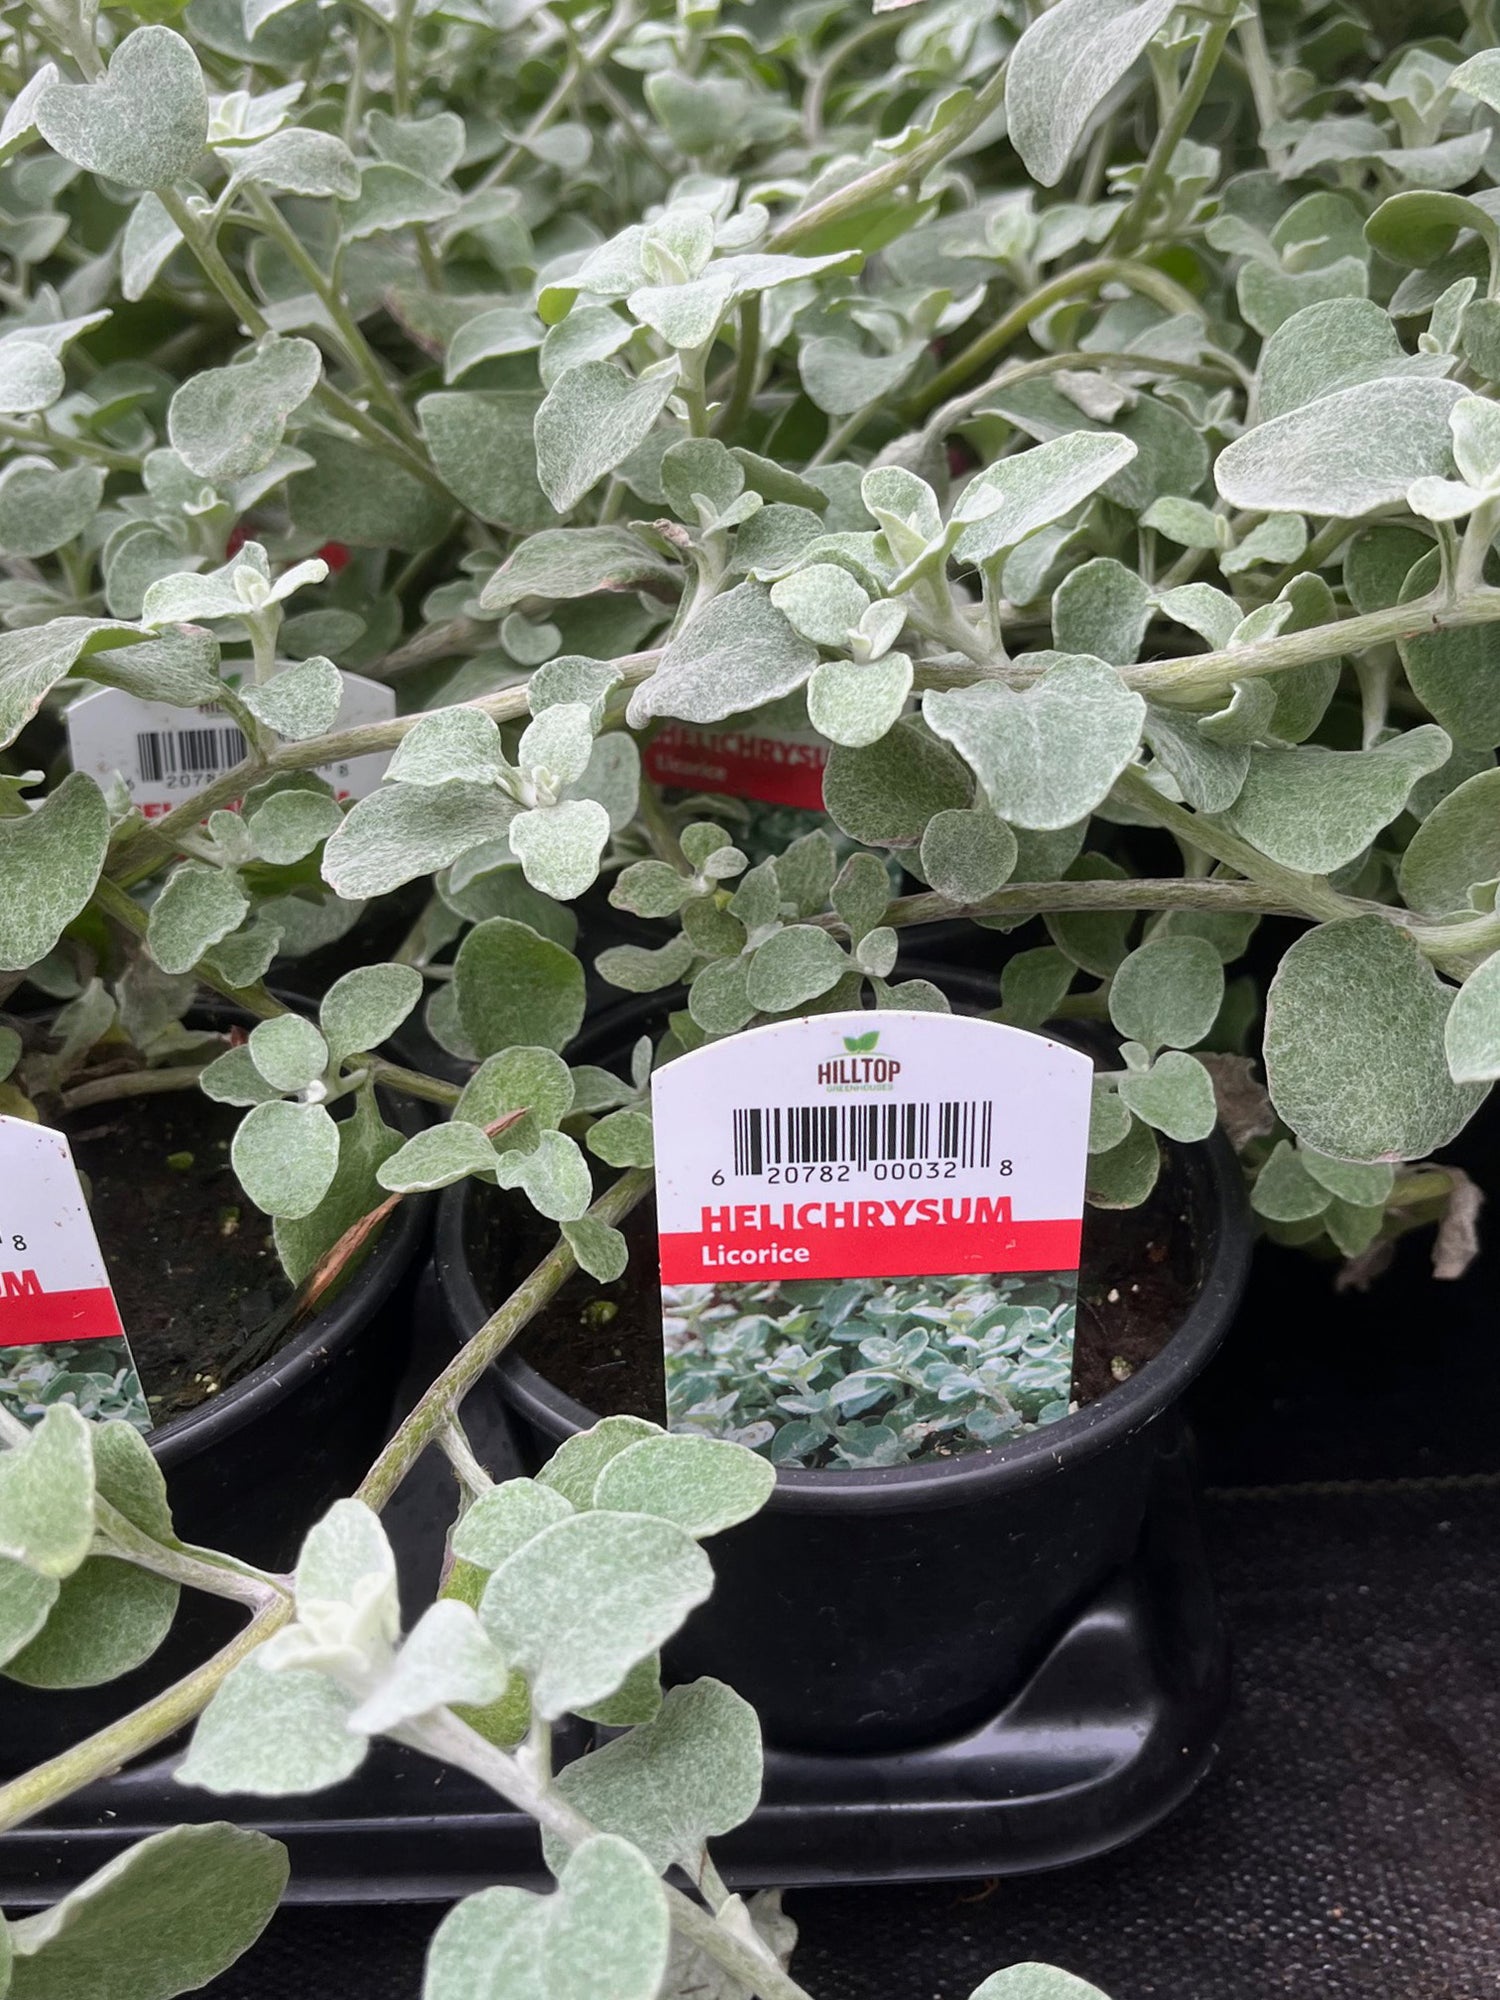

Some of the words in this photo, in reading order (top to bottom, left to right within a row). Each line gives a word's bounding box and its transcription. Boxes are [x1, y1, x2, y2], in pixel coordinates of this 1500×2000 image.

[817, 1058, 901, 1085] HILLTOP
[826, 1084, 894, 1093] GREENHOUSES
[711, 1169, 725, 1186] 6
[767, 1165, 851, 1184] 20782
[873, 1162, 957, 1181] 00032
[999, 1159, 1013, 1177] 8
[701, 1196, 1013, 1232] HELICHRYSUM
[12, 1234, 27, 1252] 8
[702, 1243, 811, 1267] Licorice
